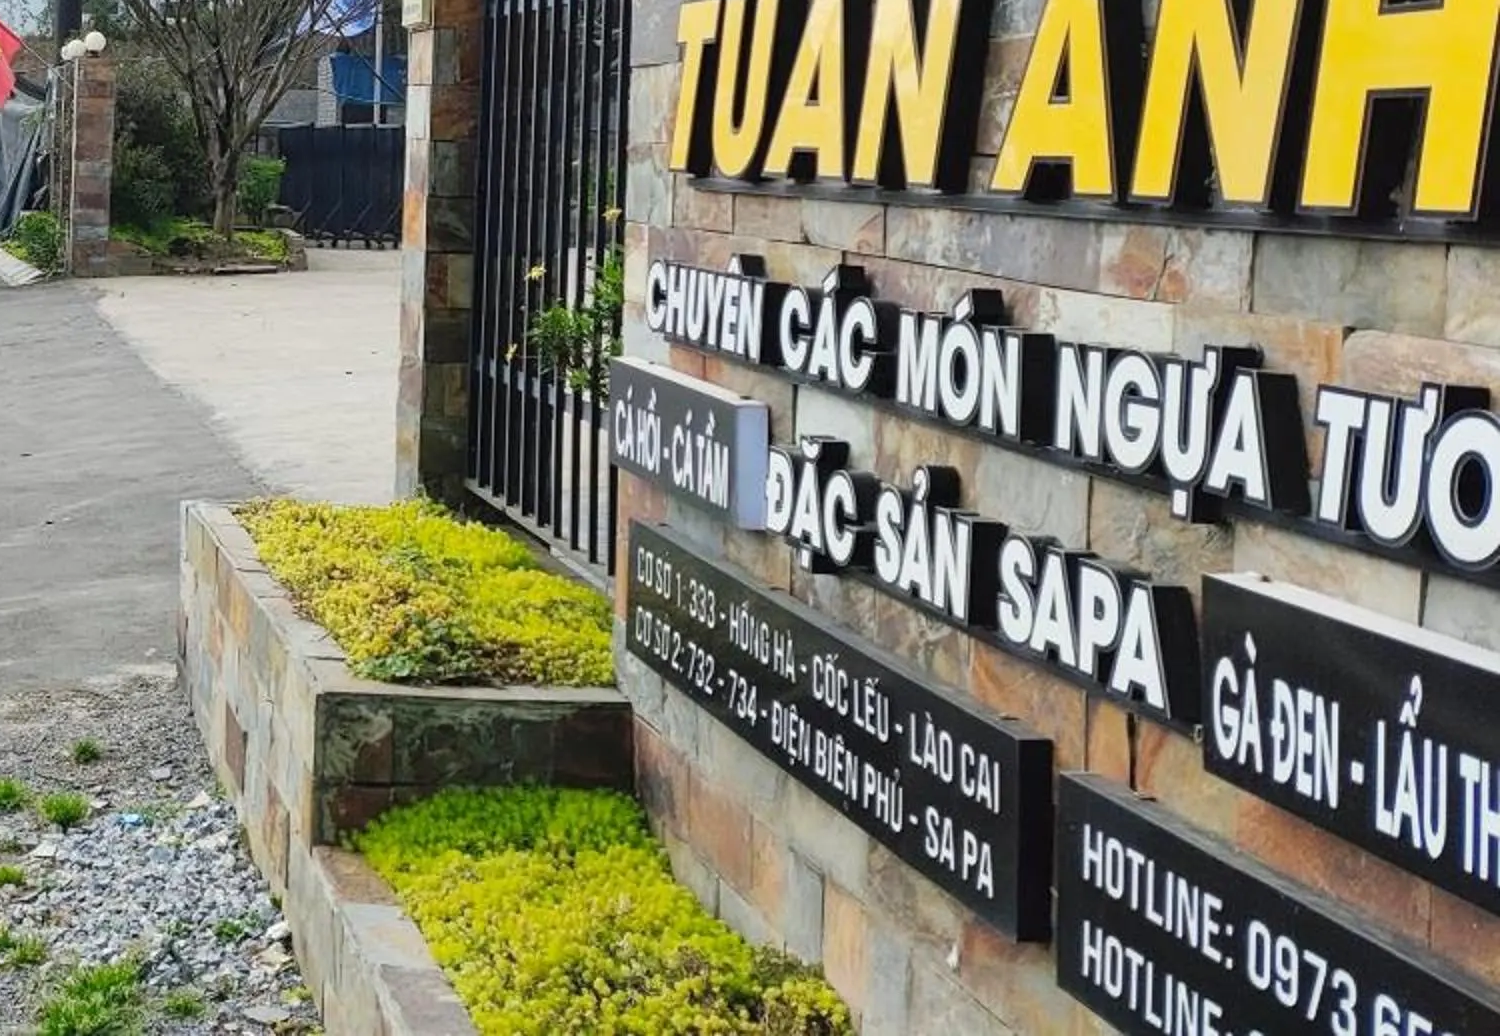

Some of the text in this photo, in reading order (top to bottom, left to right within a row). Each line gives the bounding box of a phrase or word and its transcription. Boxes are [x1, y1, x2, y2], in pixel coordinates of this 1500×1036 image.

[615, 384, 635, 461] CÁ
[636, 387, 661, 475] HỒI
[671, 409, 694, 493] CÁ
[696, 409, 730, 510] TẦM
[646, 254, 765, 364] CHUYÊN
[779, 264, 877, 391] CÁC
[898, 291, 1021, 440] MÓN
[1055, 344, 1273, 521] NGỰA
[766, 437, 1170, 720] ĐẶC SẢN SAPA
[687, 641, 715, 695] 732
[728, 669, 757, 726] 734
[771, 700, 811, 766] ĐIỆN
[815, 729, 859, 801] BIÊN
[863, 763, 903, 833] PHỦ
[925, 805, 955, 872] SA
[961, 829, 994, 899] PA
[689, 578, 716, 629] 333
[773, 628, 797, 683] HÀ
[813, 652, 849, 717] CỐC
[853, 677, 889, 743] LẾU
[909, 711, 953, 784] LÀO
[960, 743, 999, 814] CAI
[1213, 631, 1263, 773] GÀ
[1270, 678, 1339, 809] ĐEN
[1375, 674, 1447, 860] LẨU
[1081, 920, 1234, 1036] HOTLINE
[1082, 823, 1357, 1036] HOTLINE: 0973
